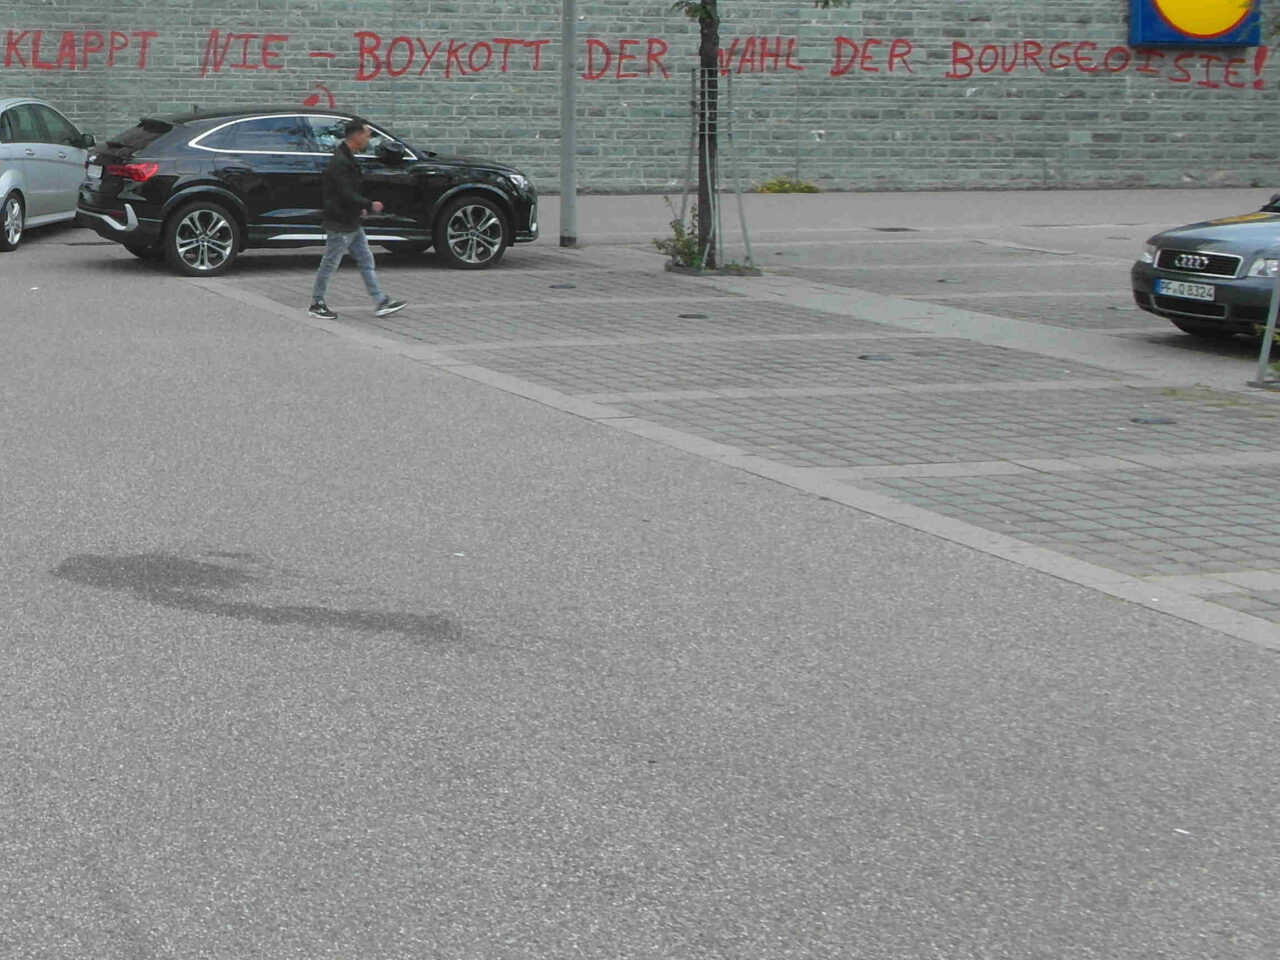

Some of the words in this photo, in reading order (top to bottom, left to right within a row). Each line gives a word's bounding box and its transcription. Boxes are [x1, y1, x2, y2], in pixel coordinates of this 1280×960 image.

[3, 29, 159, 71] KLAPPT
[201, 28, 289, 76] NIE
[352, 31, 551, 82] BOYKOTT
[581, 37, 671, 81] DER
[829, 35, 914, 77] DER
[943, 39, 1269, 91] BOURGEOISIE!
